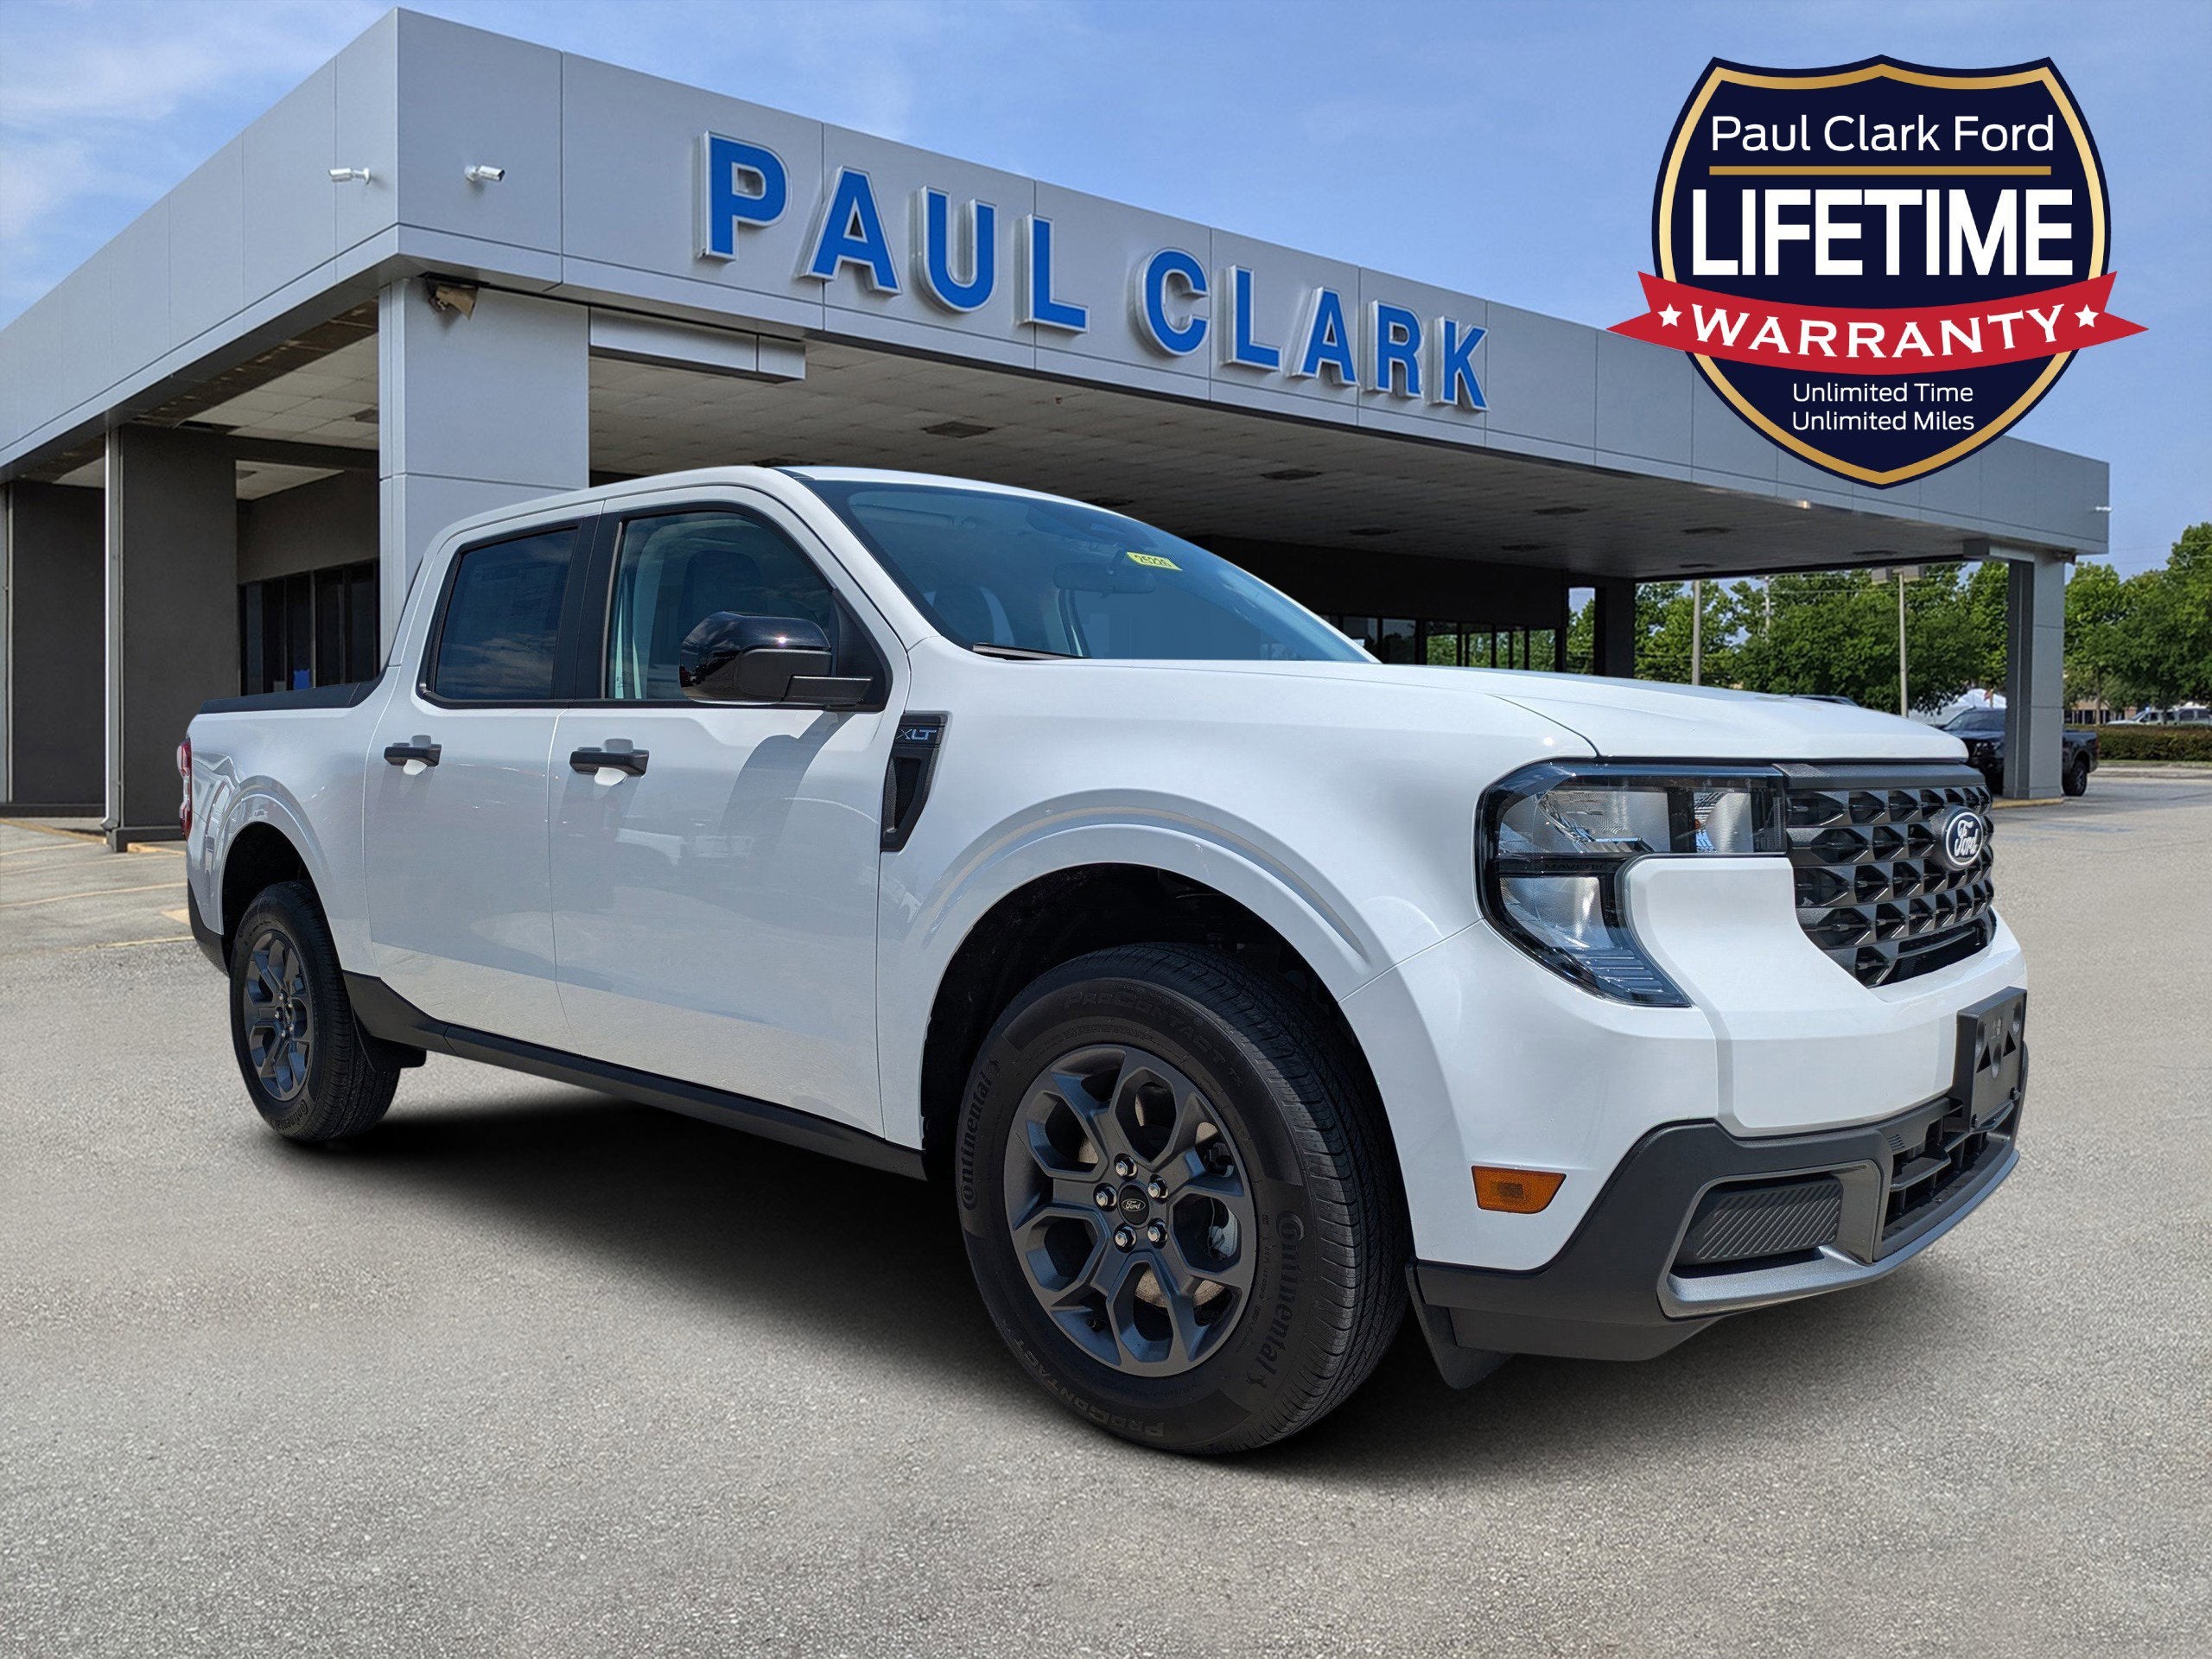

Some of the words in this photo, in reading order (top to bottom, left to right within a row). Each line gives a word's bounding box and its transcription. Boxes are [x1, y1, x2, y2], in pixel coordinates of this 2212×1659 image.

[701, 130, 1090, 334] PAUL
[1138, 247, 1491, 412] CLARK
[895, 728, 938, 741] XLT
[1954, 819, 1980, 857] Ford
[962, 1069, 995, 1211] Continental
[1125, 1197, 1141, 1210] Ford
[1256, 1211, 1306, 1375] Continental
